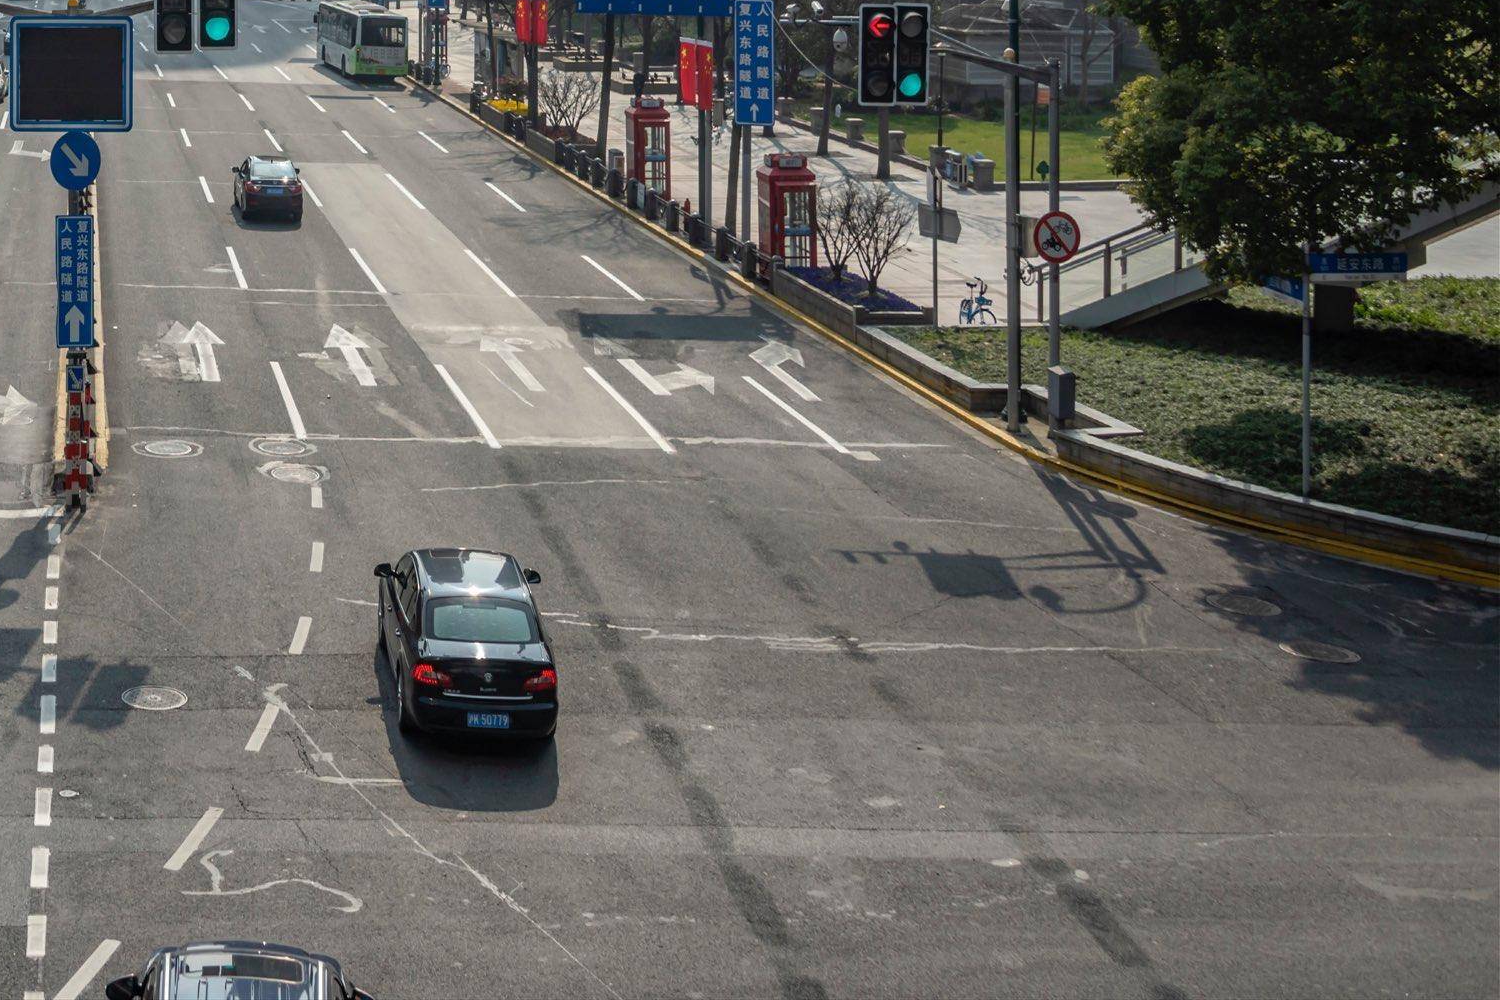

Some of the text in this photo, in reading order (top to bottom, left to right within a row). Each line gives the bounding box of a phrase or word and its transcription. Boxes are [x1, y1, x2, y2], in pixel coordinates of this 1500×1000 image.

[739, 3, 752, 100] 复兴东路隧道
[756, 3, 770, 100] 人民路隧道
[60, 220, 73, 304] 人民路隧道
[76, 220, 89, 303] 复兴东路隧道
